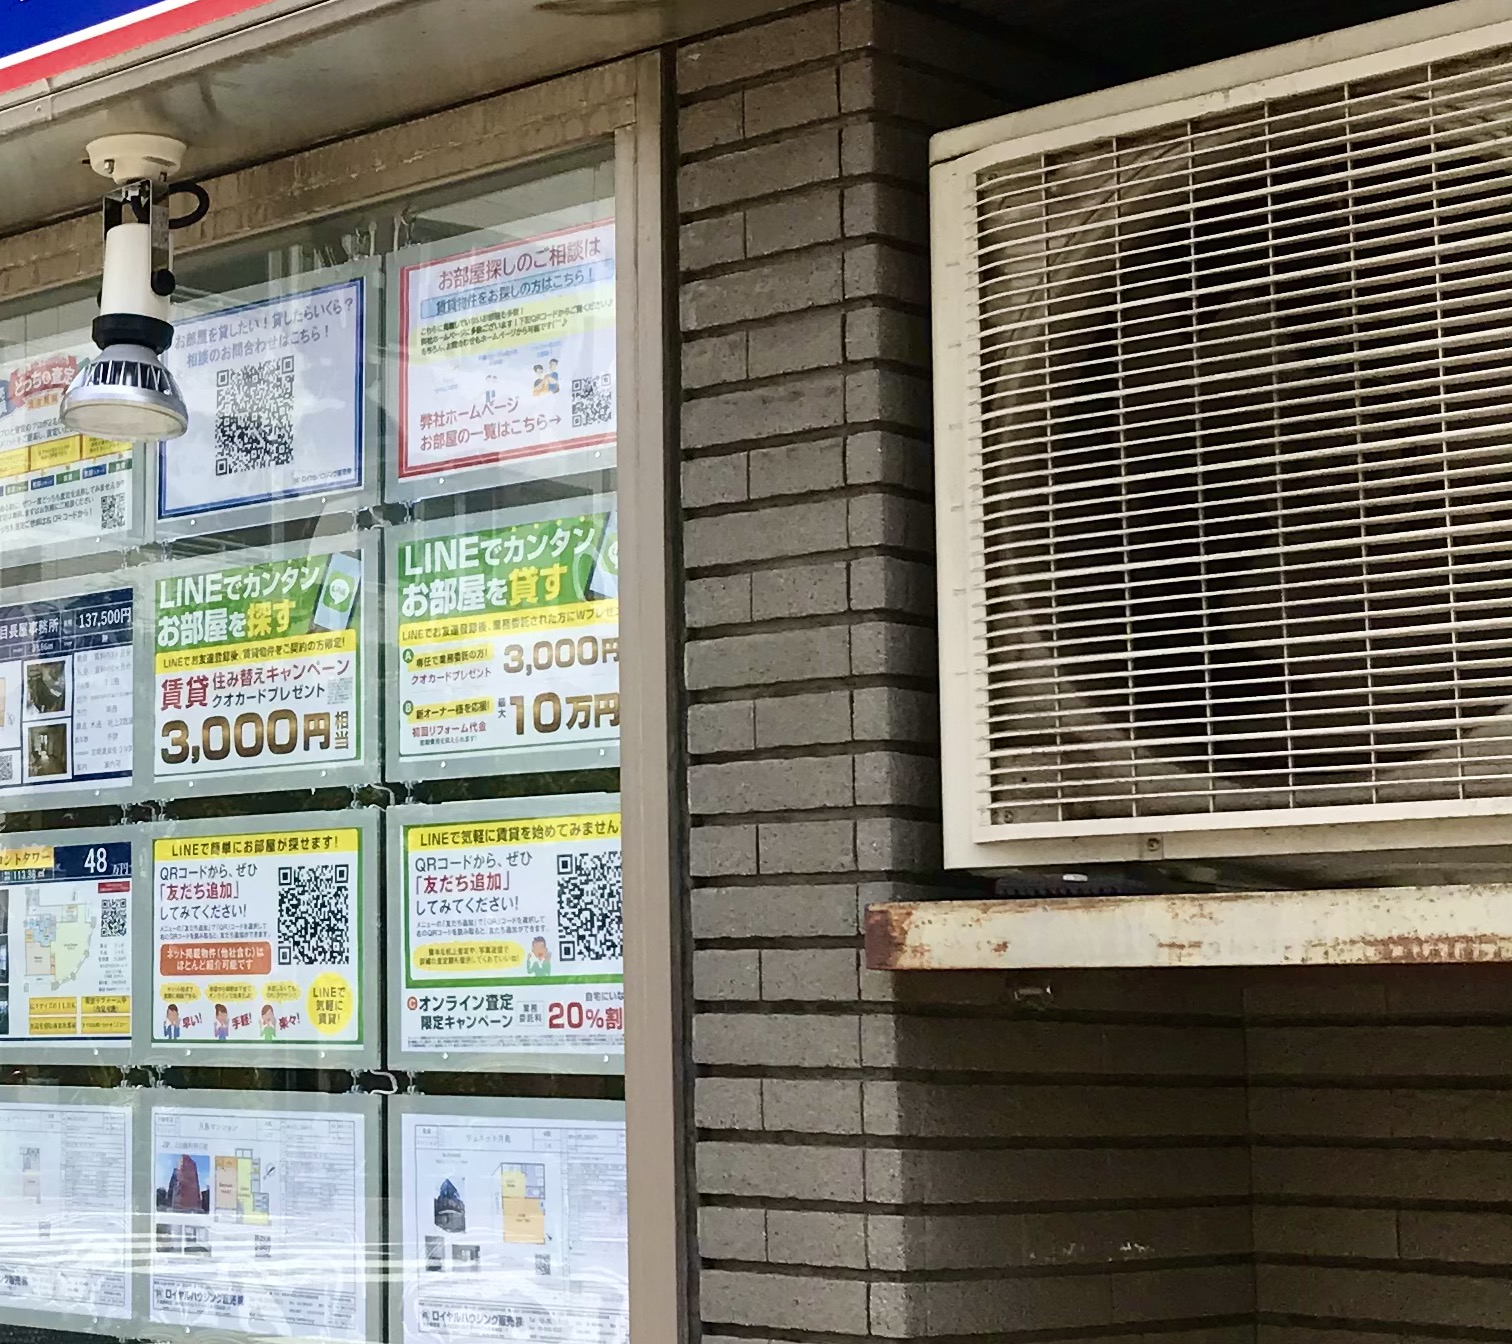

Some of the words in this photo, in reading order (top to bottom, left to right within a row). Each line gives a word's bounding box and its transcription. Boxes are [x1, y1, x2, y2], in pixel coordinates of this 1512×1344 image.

[438, 237, 600, 290] お部屋探しのご相談は
[420, 396, 519, 430] 弊社ホームページ
[404, 527, 595, 576] LINEでカンタン
[159, 566, 320, 608] LINEでカンタン
[402, 563, 568, 617] お部屋を貸す
[78, 607, 132, 630] 137,500円
[157, 599, 296, 647] お部屋を探す
[504, 636, 619, 676] 3,000円
[212, 660, 350, 690] 住み替えキャンペーン
[411, 668, 491, 685] クオカードプレゼント
[161, 676, 209, 711] 賃貸
[212, 684, 325, 709] クオカードプレゼント
[509, 692, 619, 736] 10万円
[161, 709, 330, 764] 3,000円
[172, 836, 339, 856] LINEで簡単にお部屋が探せます!
[420, 820, 620, 848] LINEで気軽に賃貸を始めてみません
[160, 863, 258, 881] QRコードから、ぜひ
[415, 850, 533, 872] QRコードから、ぜひ
[160, 882, 239, 902] 「友だち追加」
[416, 872, 510, 895] 「友だち追加」
[160, 904, 247, 921] してみてください!
[416, 896, 519, 916] してみてください!
[313, 986, 346, 998] LINEで
[419, 993, 514, 1012] オンライン査定
[420, 1015, 513, 1031] 限定キャンペーン
